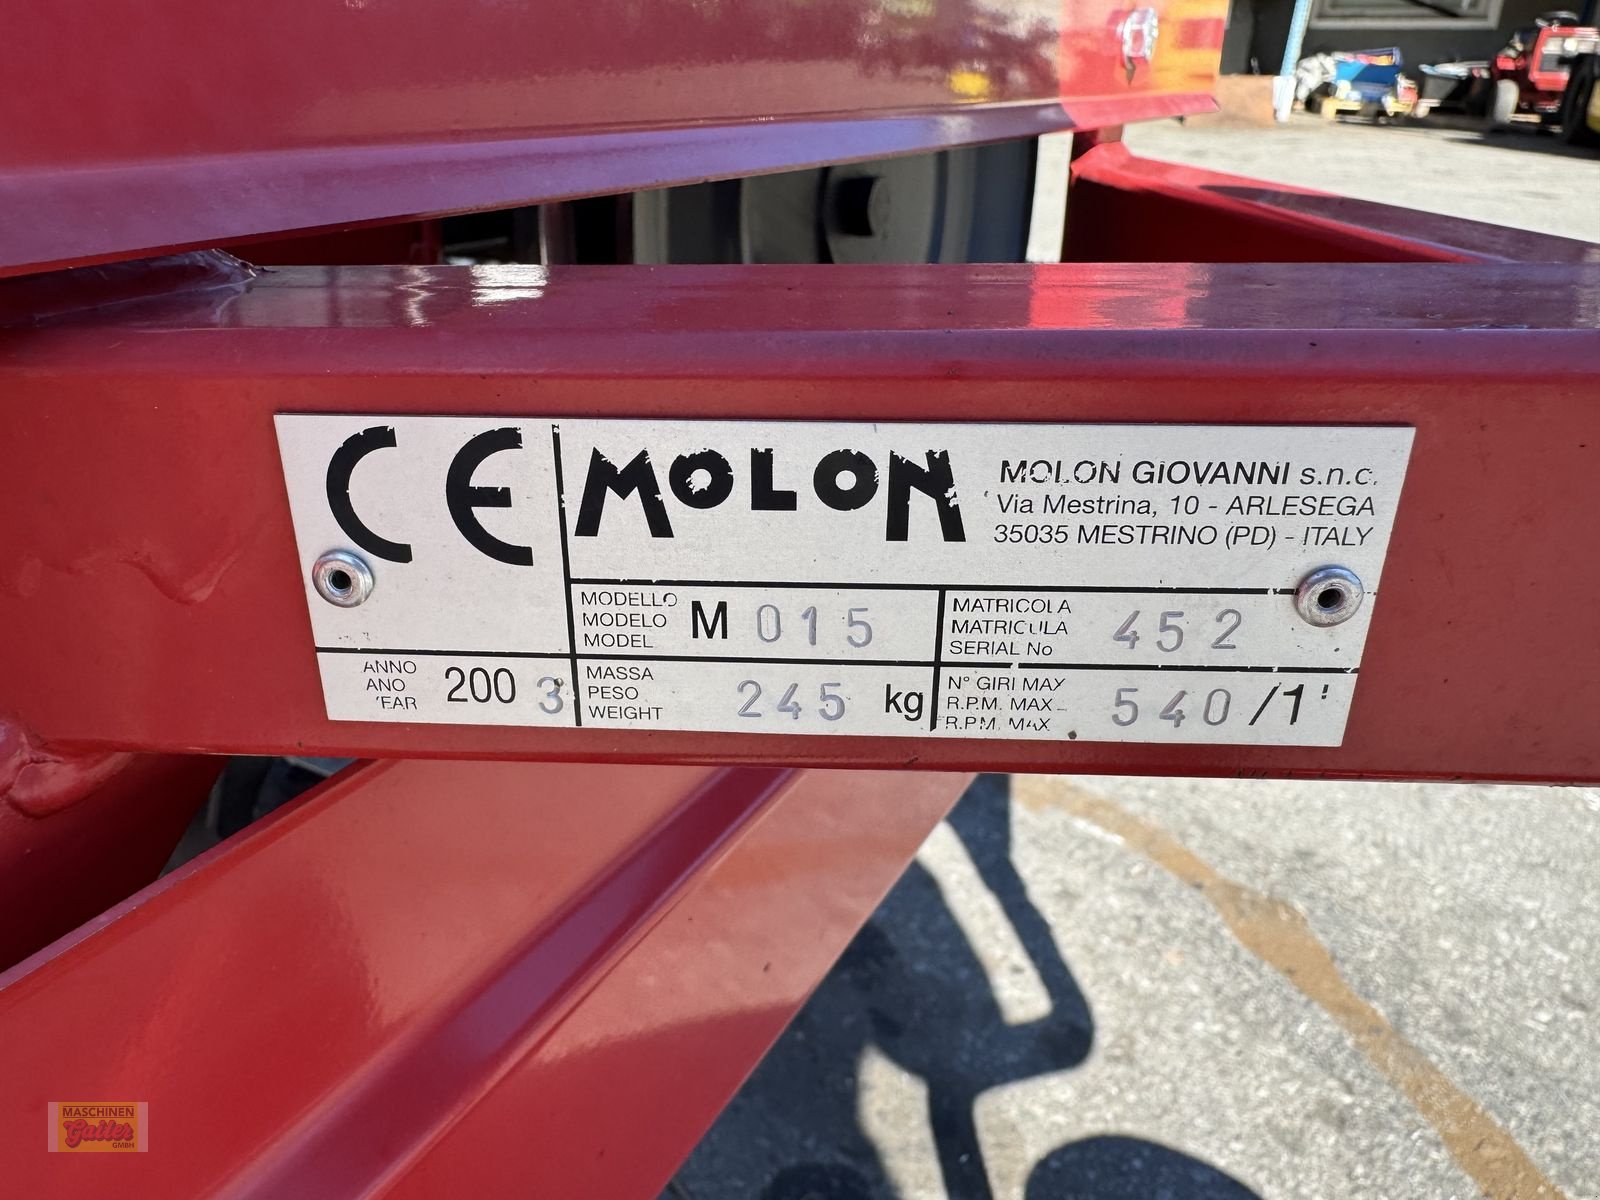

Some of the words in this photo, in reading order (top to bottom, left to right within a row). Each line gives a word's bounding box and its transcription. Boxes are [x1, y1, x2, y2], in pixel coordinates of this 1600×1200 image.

[1000, 460, 1121, 484] MOLON
[1132, 460, 1290, 486] GIOVANNI
[1299, 466, 1377, 486] s.n.c.
[575, 446, 966, 542] MOLON
[997, 495, 1034, 515] Via
[1043, 495, 1158, 518] Mestrina,
[1170, 496, 1199, 515] 10
[1225, 496, 1376, 516] ARLESEGA
[993, 525, 1068, 544] 35035
[1077, 525, 1217, 546] MESTRINO
[1225, 525, 1277, 550] (PD)
[1302, 527, 1373, 546] ITALY
[580, 591, 678, 607] MODELLO
[952, 598, 1072, 614] MATRICOLA
[583, 612, 667, 628] MODELO
[691, 600, 728, 639] M
[951, 619, 1069, 635] MATRICULA
[584, 633, 654, 648] MODEL
[949, 640, 1020, 656] SERIAL
[1027, 641, 1053, 656] No
[363, 660, 417, 674] ANNO
[586, 665, 654, 681] MASSA
[366, 678, 406, 691] ANO
[976, 675, 1016, 691] GIRI
[1022, 676, 1066, 691] MAX
[588, 685, 639, 700] PESO
[376, 696, 418, 710] EAR
[885, 684, 924, 722] kg
[947, 696, 1002, 711] R.P.M.
[1010, 697, 1053, 712] MAX
[589, 705, 663, 721] WEIGHT
